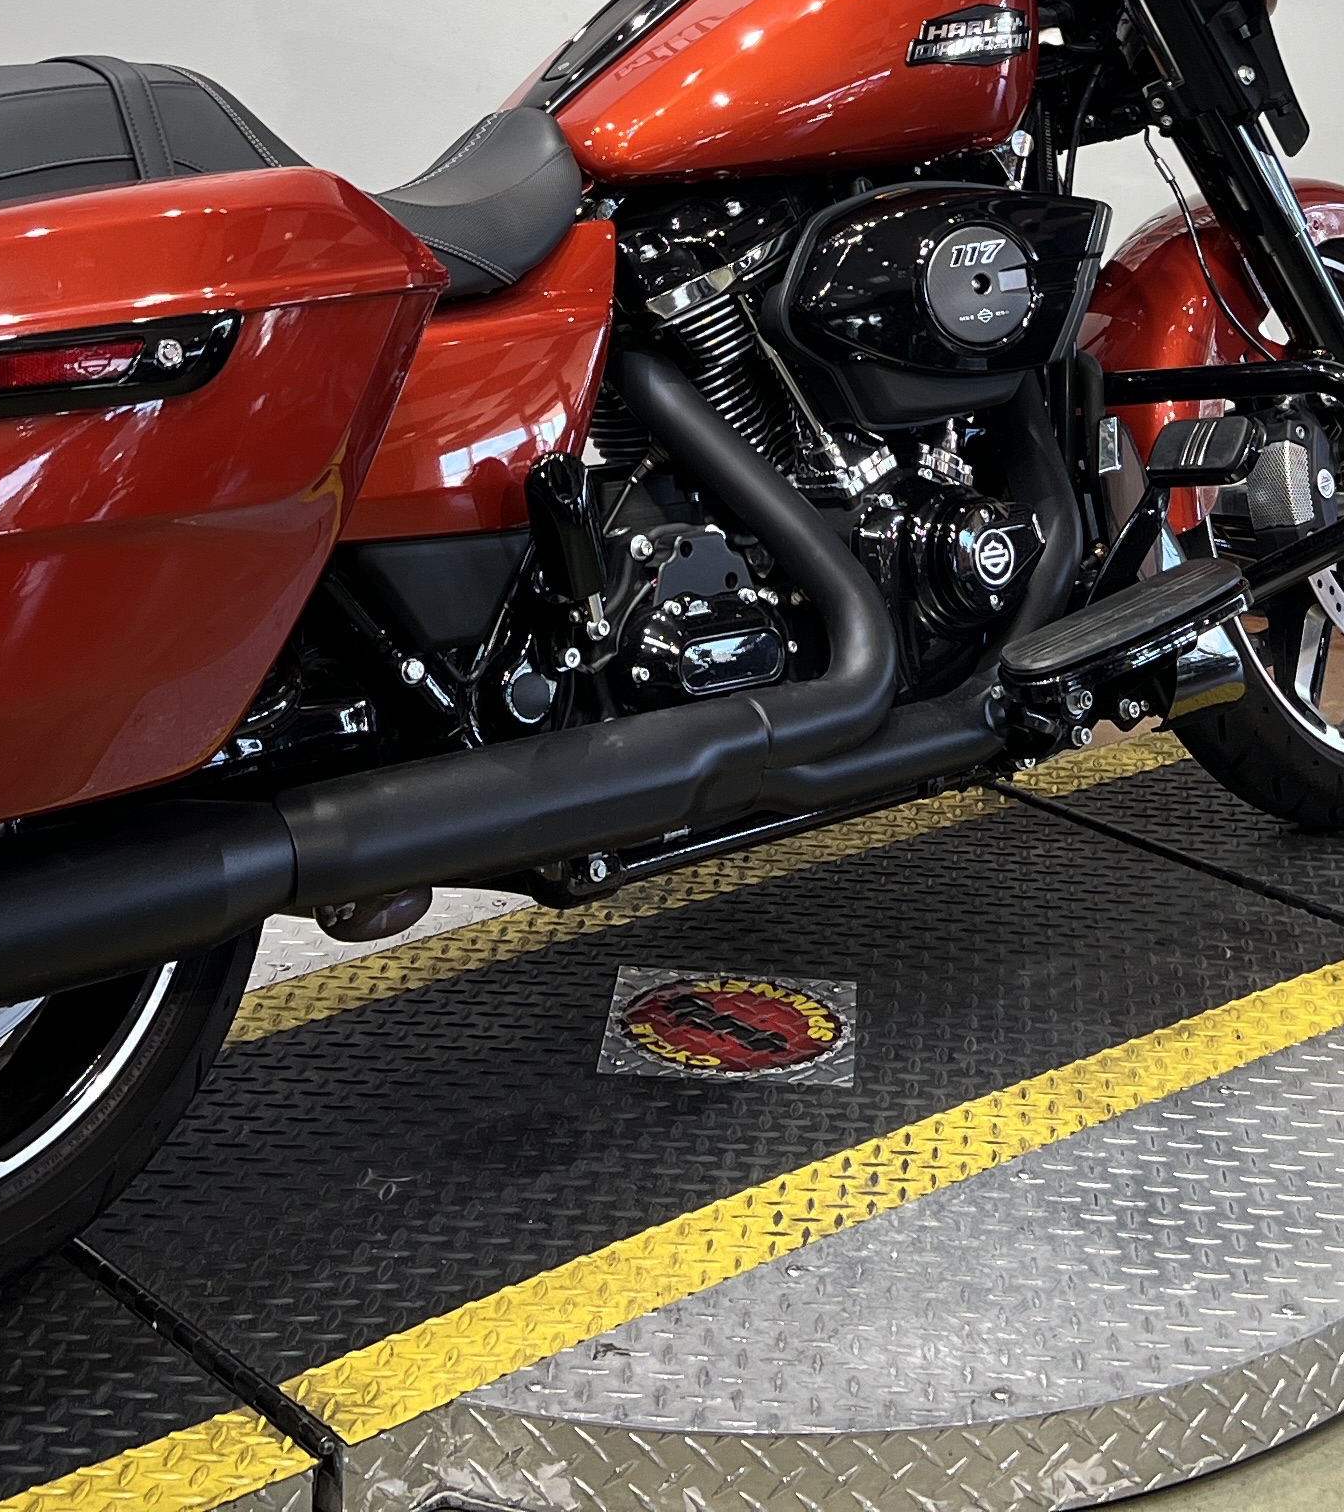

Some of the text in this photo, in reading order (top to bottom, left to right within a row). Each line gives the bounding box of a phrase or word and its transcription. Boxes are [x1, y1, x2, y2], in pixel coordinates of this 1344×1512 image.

[949, 239, 1007, 268] 117
[629, 979, 836, 1067] CYCLE SPINNER
